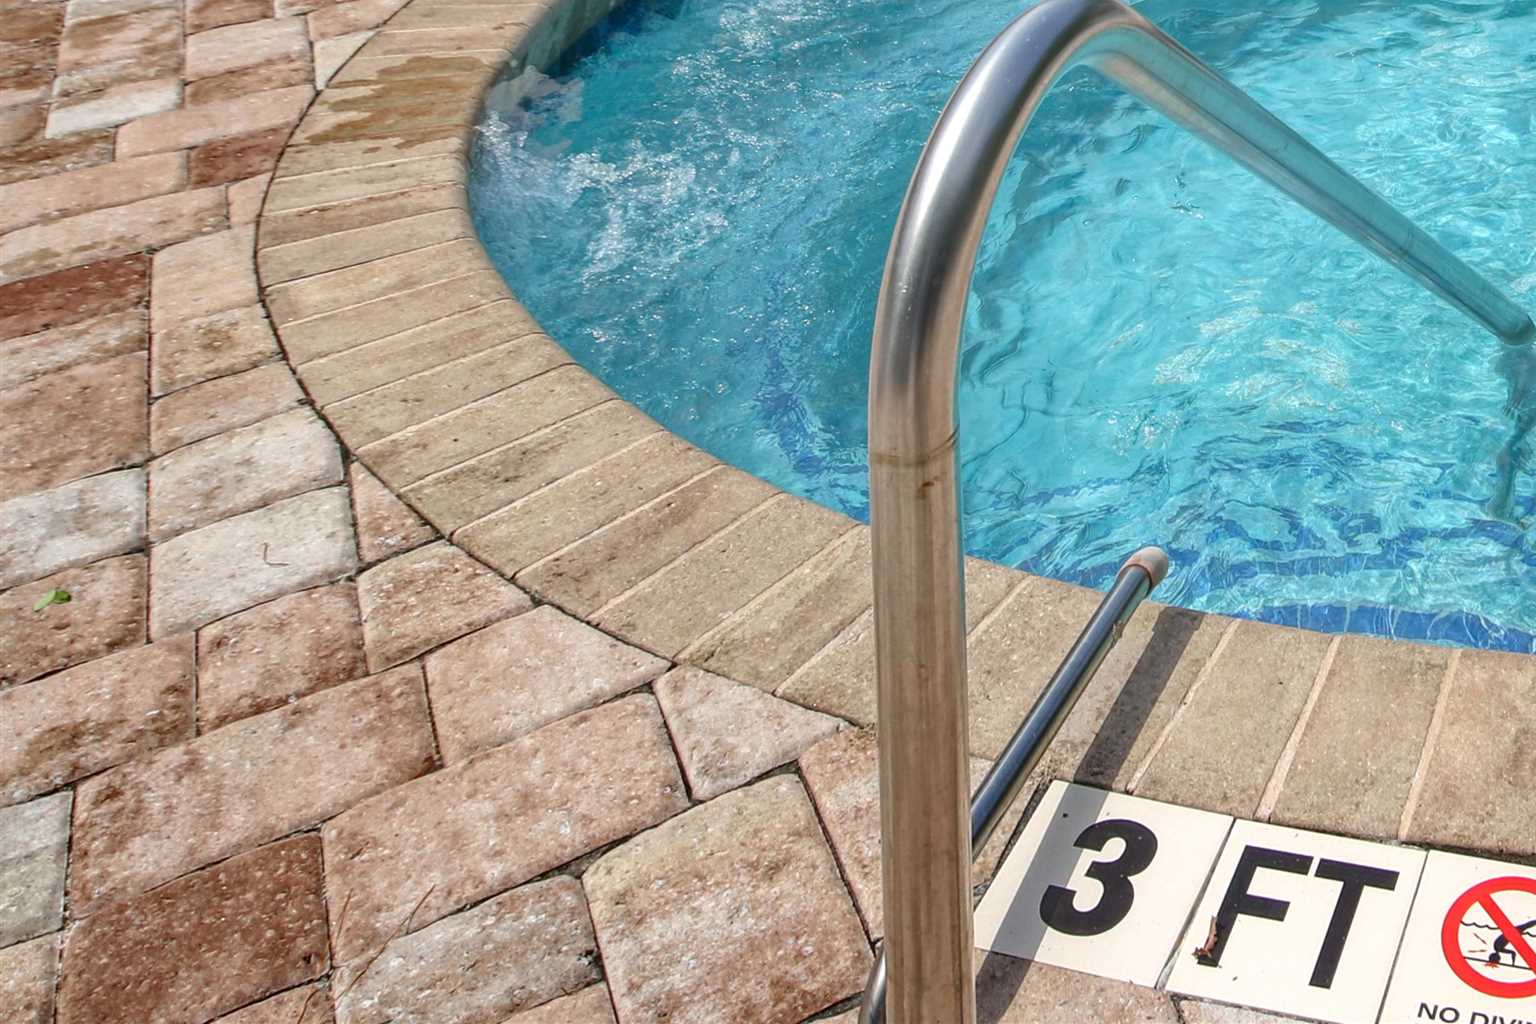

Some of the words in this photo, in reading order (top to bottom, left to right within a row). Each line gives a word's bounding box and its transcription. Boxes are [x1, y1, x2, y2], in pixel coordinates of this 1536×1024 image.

[1039, 818, 1159, 937] 3
[1196, 844, 1401, 990] FT
[1417, 1002, 1460, 1023] NO
